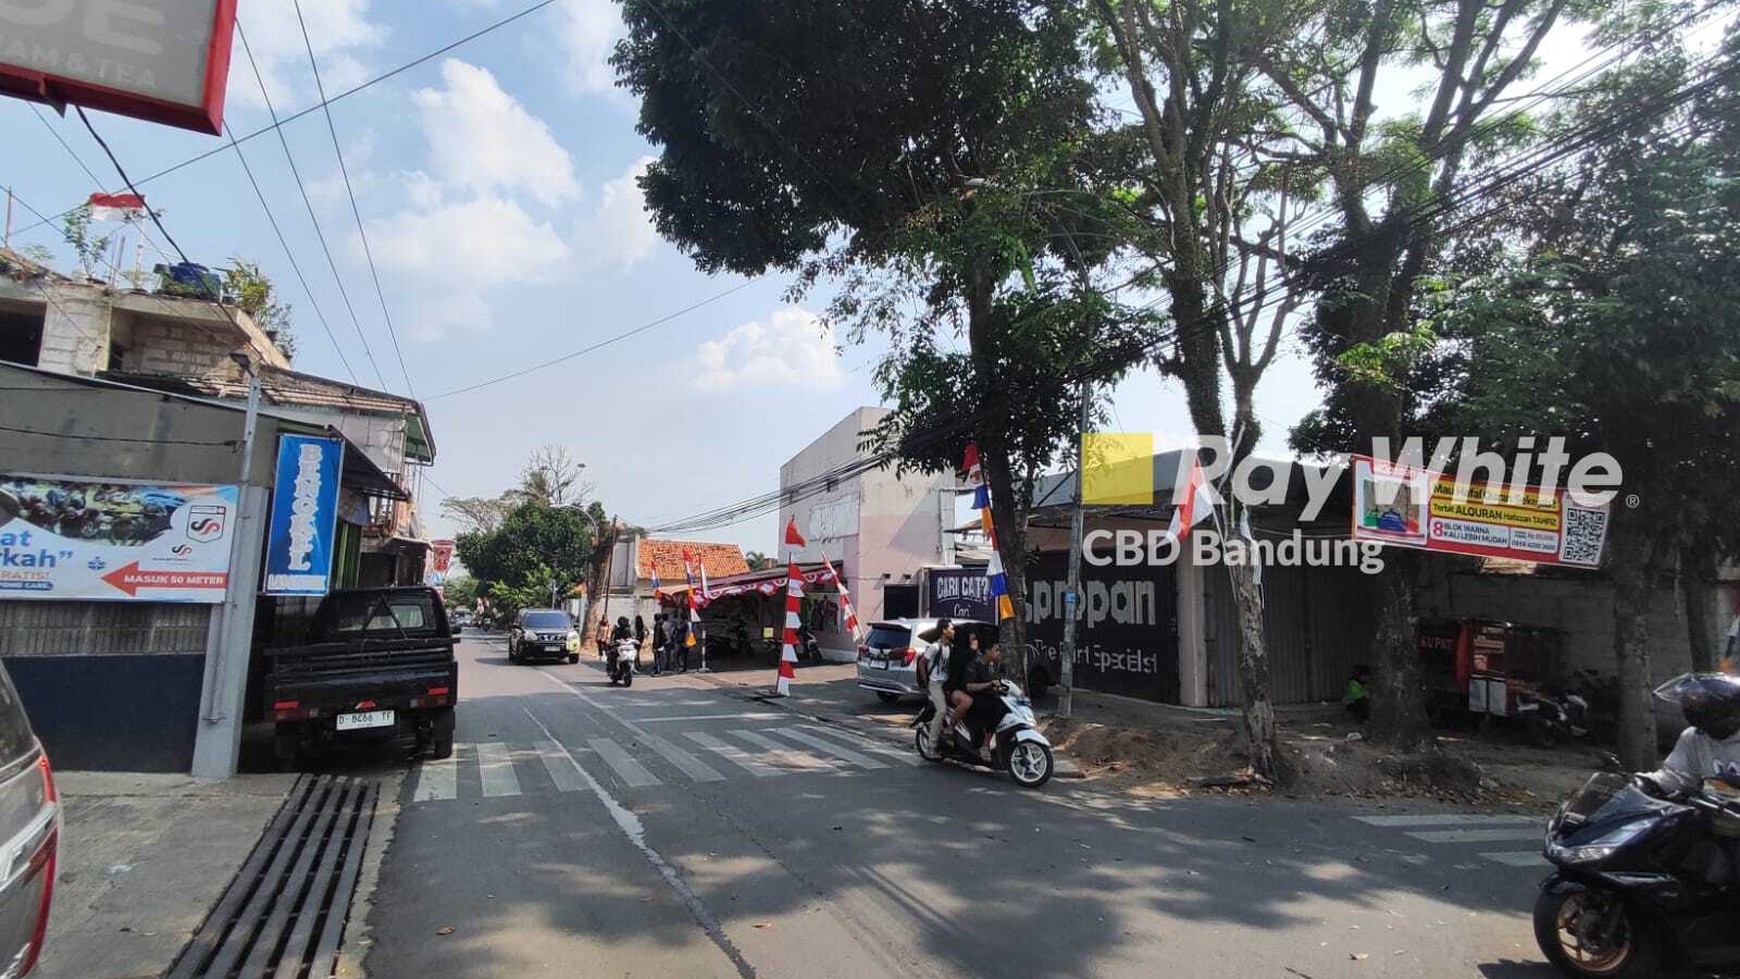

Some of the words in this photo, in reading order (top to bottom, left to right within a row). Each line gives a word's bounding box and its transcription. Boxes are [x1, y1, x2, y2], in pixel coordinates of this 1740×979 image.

[0, 36, 60, 66] AM
[95, 57, 157, 88] TEA
[1455, 504, 1502, 519] ALQURAN
[1433, 521, 1444, 536] 8
[1444, 523, 1462, 531] BLOK
[1463, 524, 1490, 534] WARNA
[1482, 535, 1508, 545] MUDAH
[0, 548, 73, 567] kah”
[124, 575, 168, 584] MASUK
[171, 575, 182, 584] 50
[186, 576, 224, 585] METER
[937, 577, 959, 598] CARI
